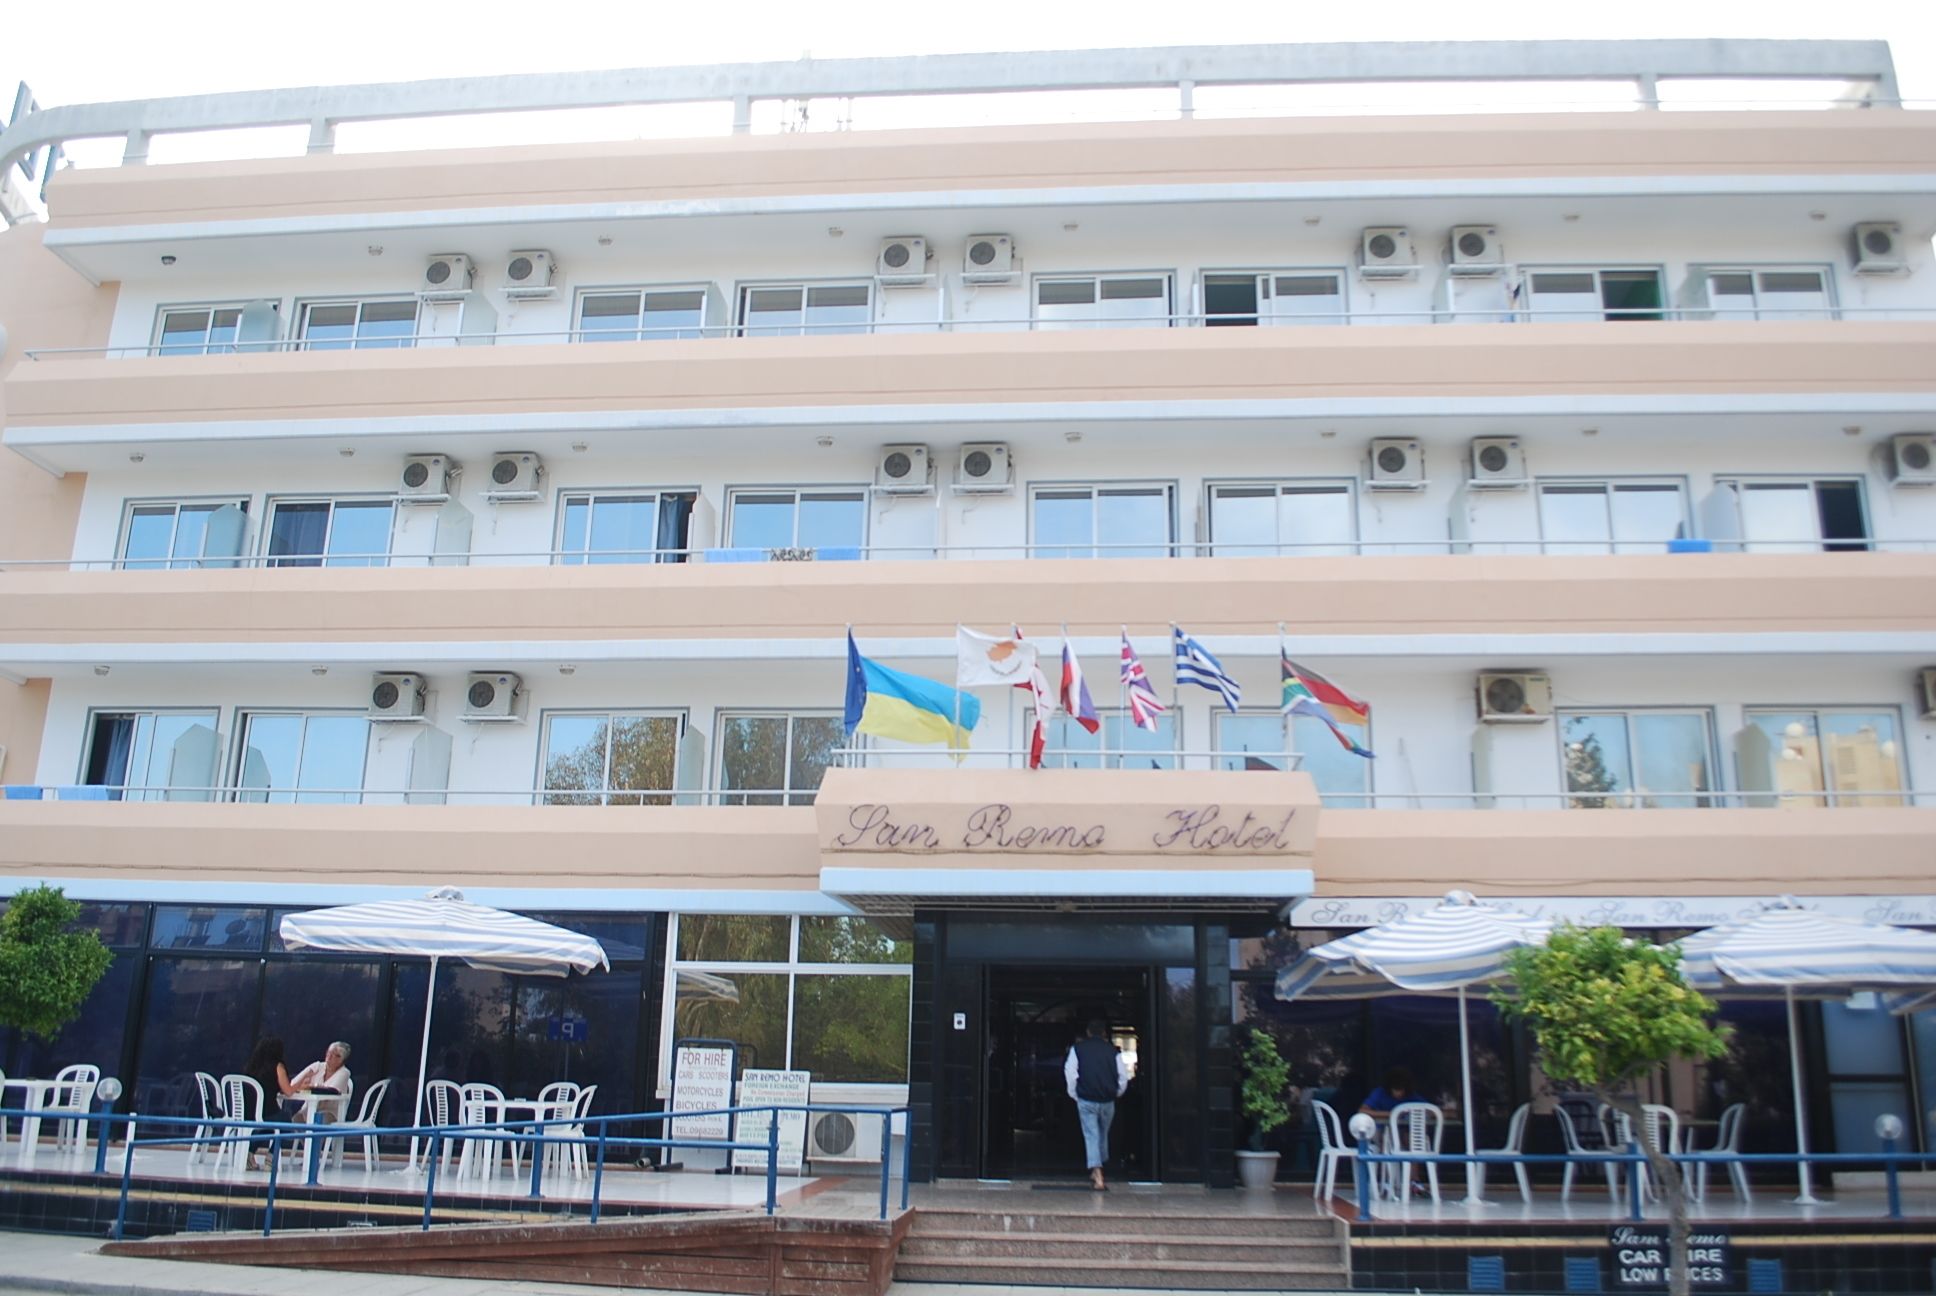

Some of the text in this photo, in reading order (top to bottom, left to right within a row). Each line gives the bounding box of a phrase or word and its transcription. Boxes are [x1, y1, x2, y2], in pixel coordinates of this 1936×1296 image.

[838, 804, 1296, 849] San Remo Hotel
[1312, 901, 1370, 924] San
[1587, 901, 1646, 923] San
[681, 1052, 727, 1066] FOR HIRE
[745, 1072, 758, 1081] SAN
[782, 1073, 805, 1083] HOTEL
[677, 1085, 724, 1096] MOTORCYCLES
[676, 1100, 717, 1110] BICYCLES
[1611, 1227, 1726, 1245] San emo
[1618, 1249, 1723, 1264] CAR IRE
[1620, 1267, 1658, 1282] LOW
